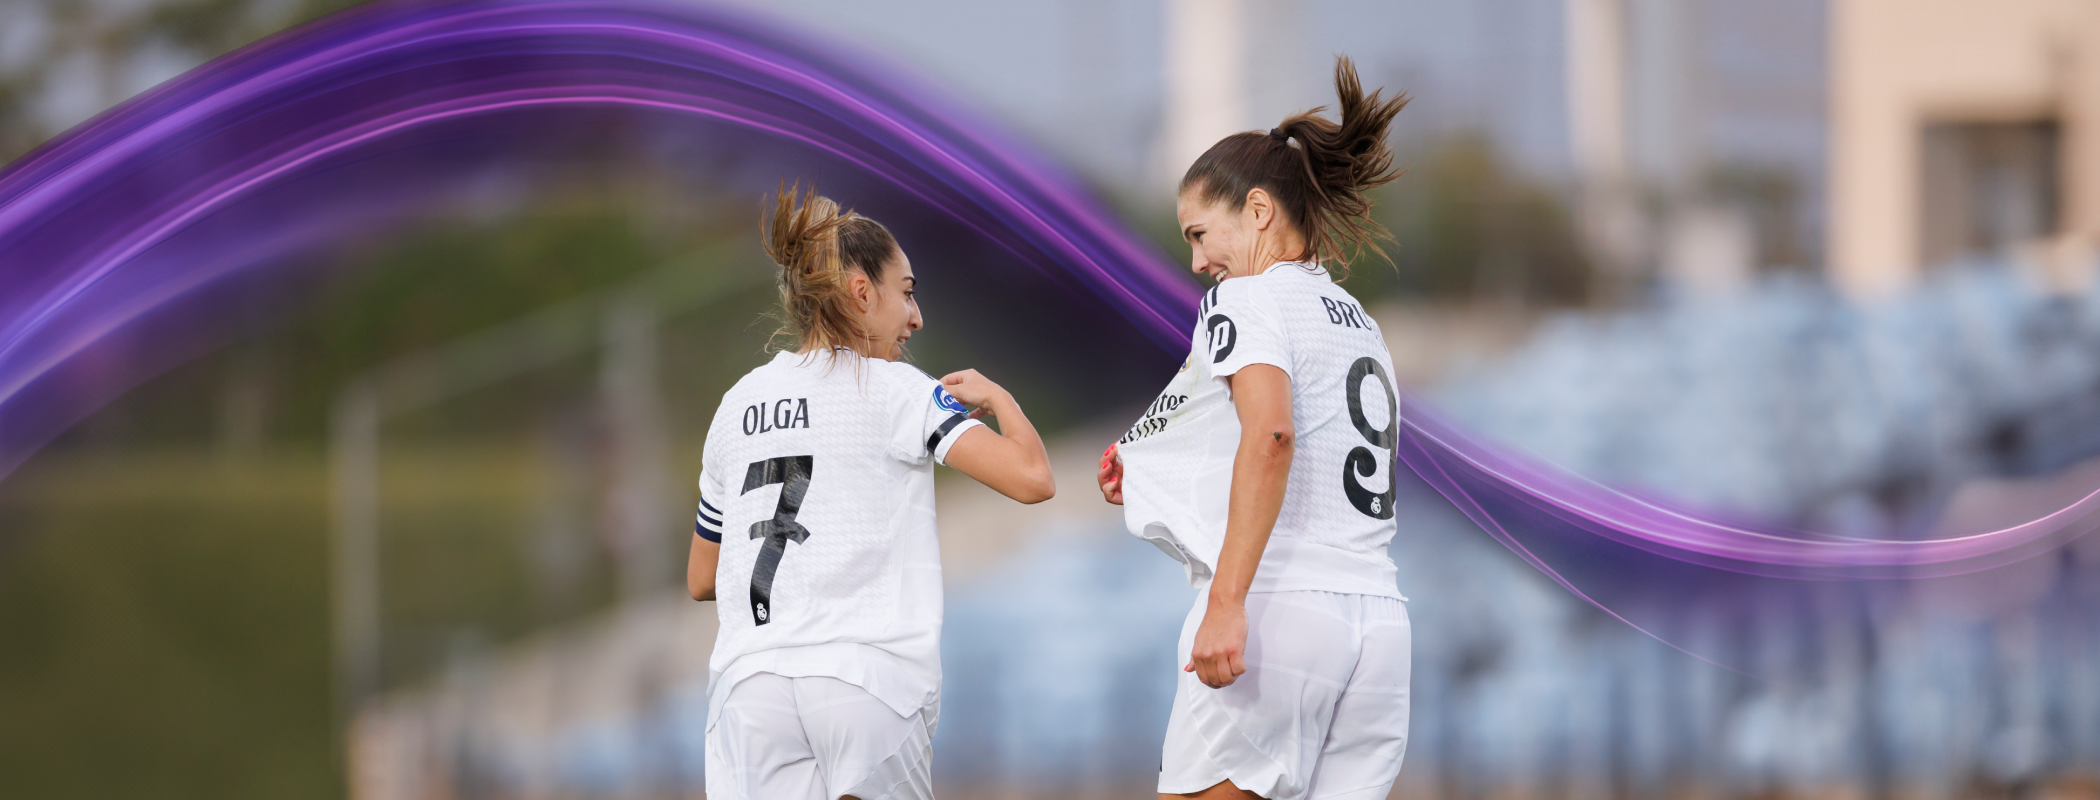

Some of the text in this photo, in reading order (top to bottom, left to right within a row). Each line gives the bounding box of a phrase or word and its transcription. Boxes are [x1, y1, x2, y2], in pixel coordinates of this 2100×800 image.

[1320, 296, 1380, 341] BRU
[743, 398, 809, 436] OLGA
[1146, 391, 1188, 418] ates
[1343, 356, 1397, 520] 9
[740, 455, 813, 626] 7
